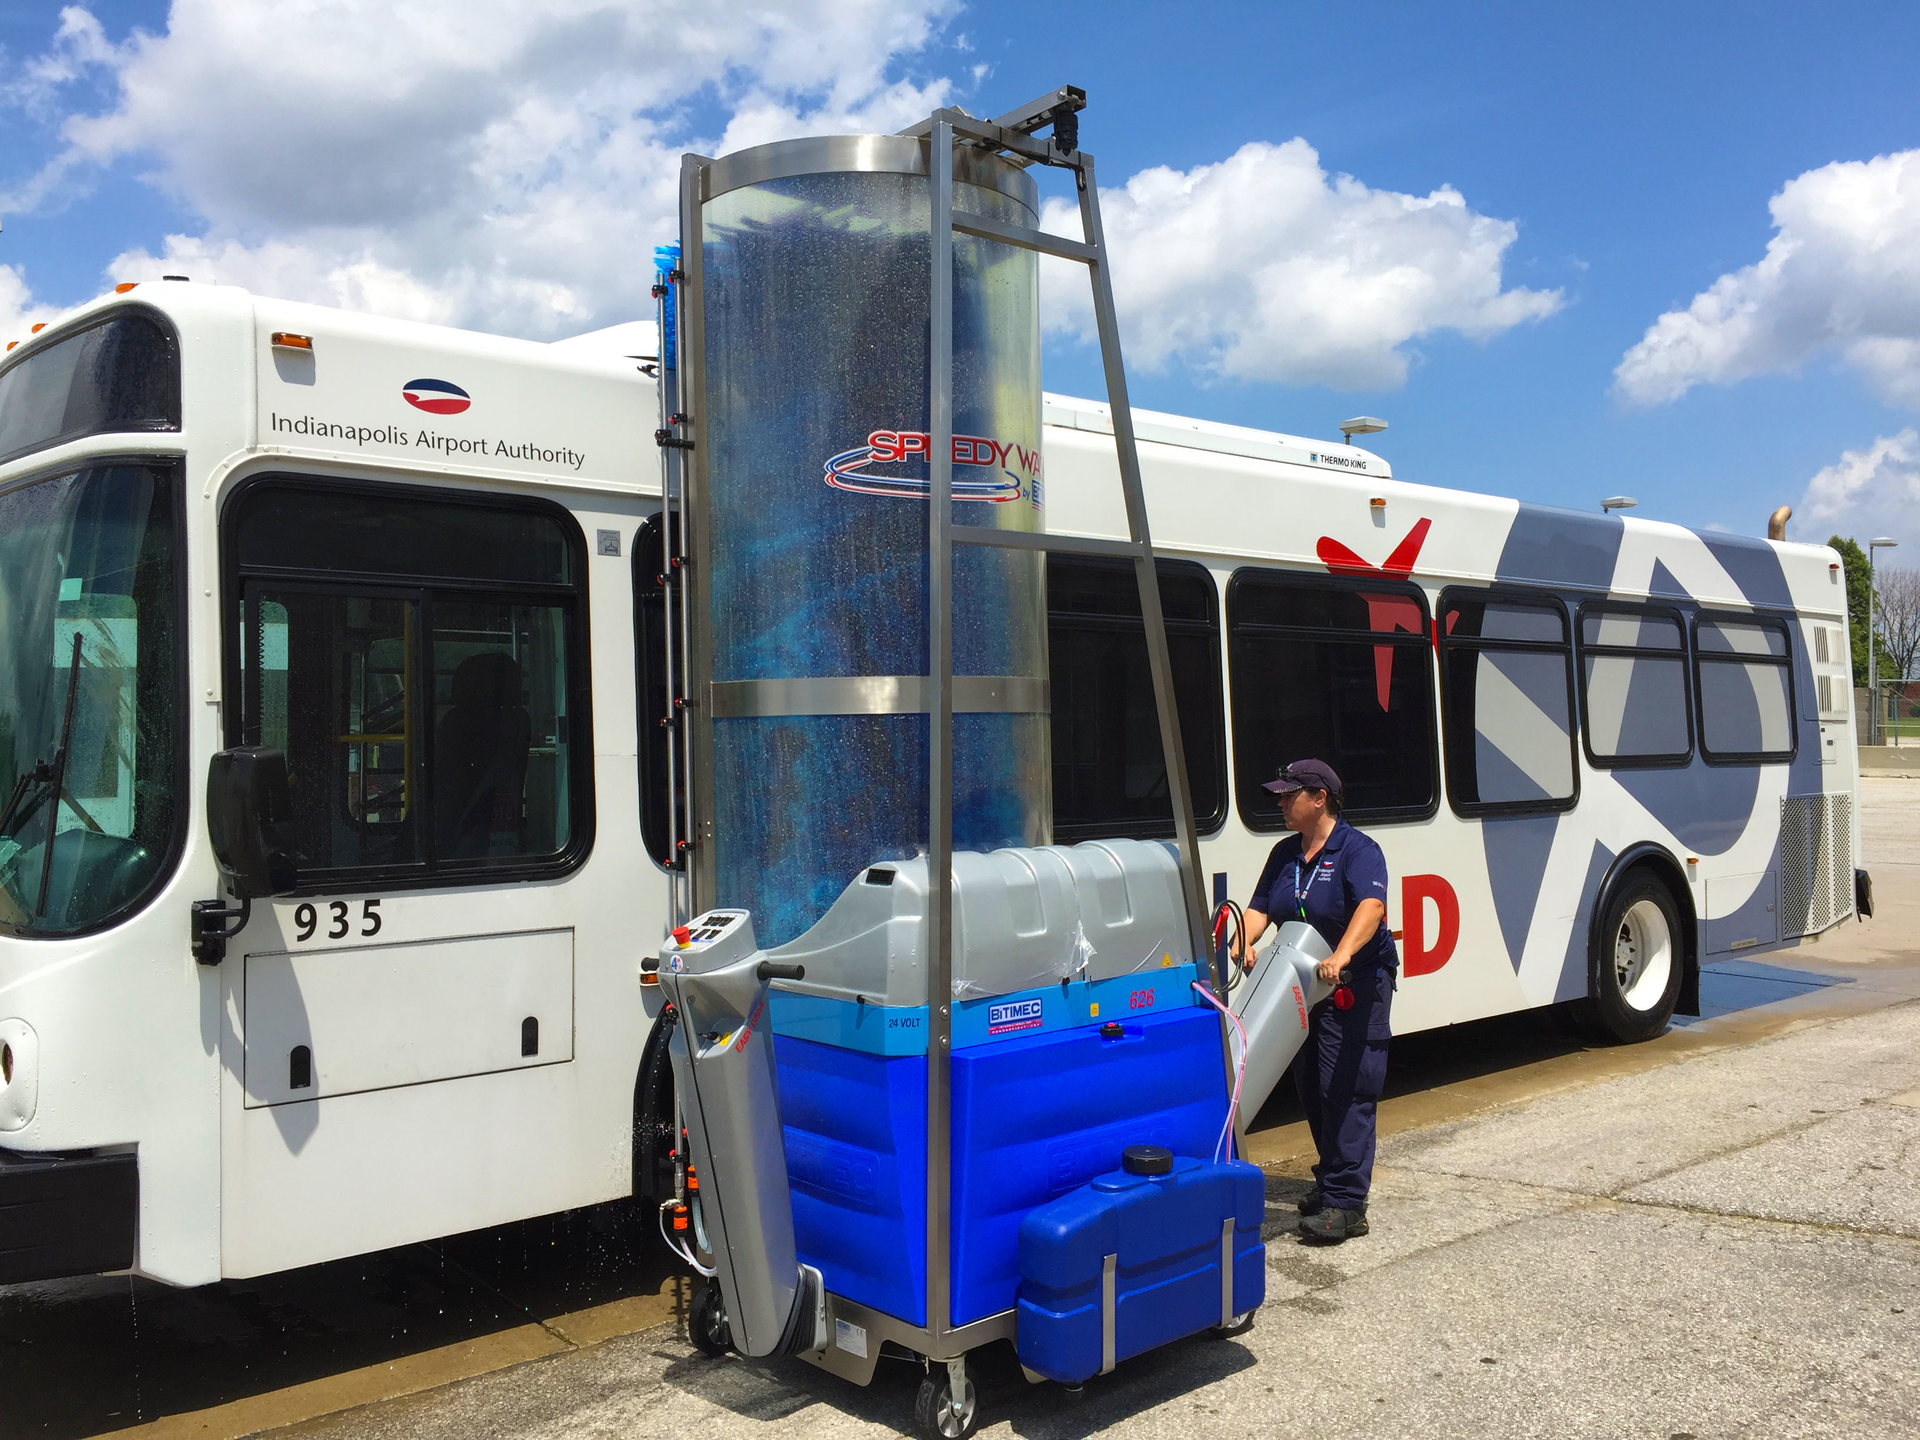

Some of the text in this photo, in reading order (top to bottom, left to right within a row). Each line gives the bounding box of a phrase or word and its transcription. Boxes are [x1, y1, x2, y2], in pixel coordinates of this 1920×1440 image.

[271, 412, 586, 471] Indianapolis Airport Authority
[1320, 454, 1350, 467] THERMO
[1350, 459, 1367, 470] KING
[1022, 487, 1031, 500] by
[294, 898, 382, 943] 935
[1129, 987, 1155, 1010] 626
[1291, 985, 1304, 1006] EASY
[888, 1017, 922, 1028] 24 VOLT
[734, 1025, 752, 1053] EASY
